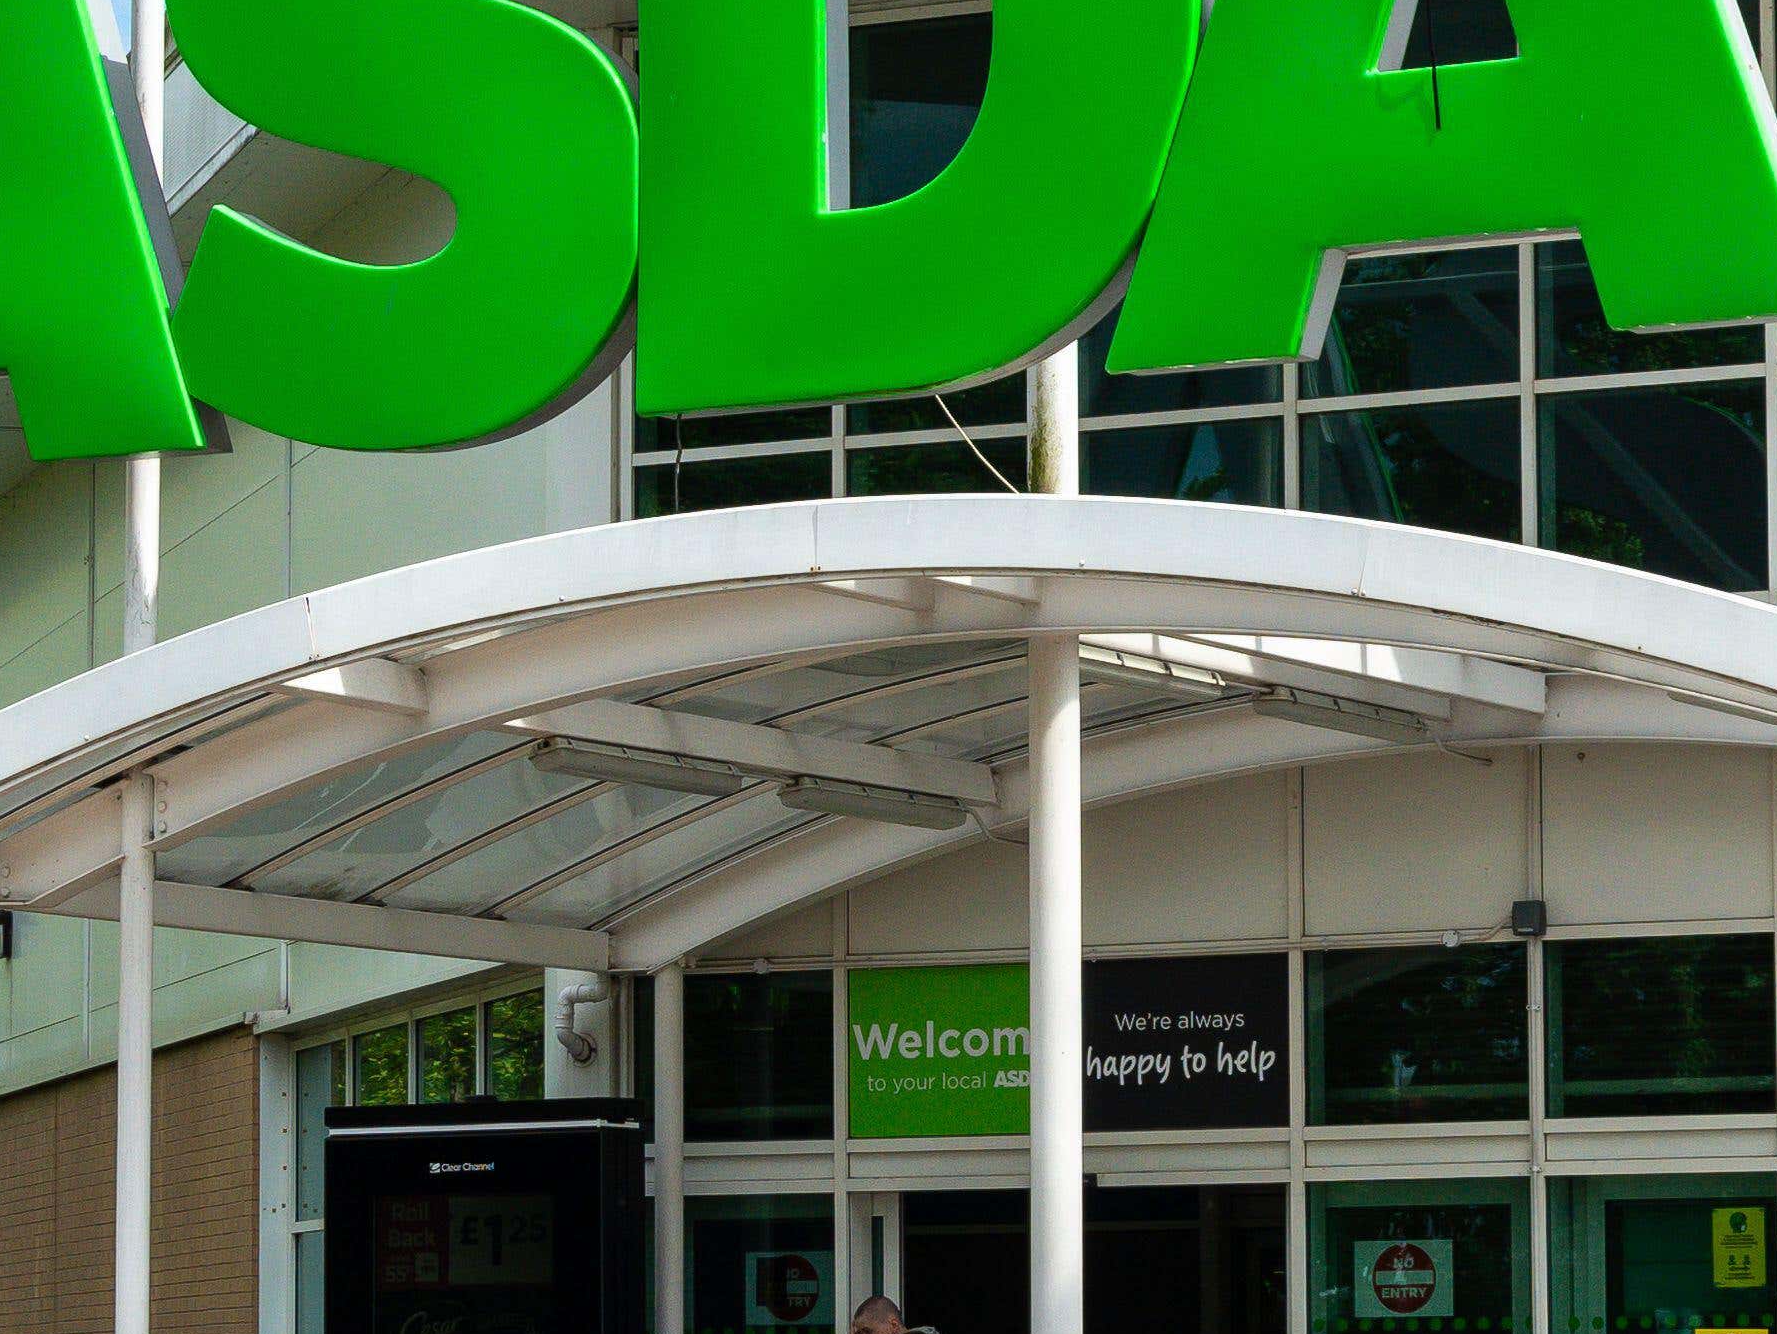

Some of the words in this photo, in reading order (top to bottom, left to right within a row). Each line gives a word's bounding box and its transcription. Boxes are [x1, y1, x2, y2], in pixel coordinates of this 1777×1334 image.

[1115, 1013, 1172, 1031] We're
[1177, 1011, 1245, 1031] always
[852, 1020, 1030, 1061] Welcom
[1086, 1046, 1171, 1086] happy
[1180, 1045, 1207, 1079] to
[1217, 1040, 1276, 1081] help
[867, 1075, 887, 1092] to
[893, 1076, 936, 1095] your
[942, 1071, 987, 1090] local
[993, 1070, 1030, 1088] ASD
[442, 1163, 462, 1172] Clear
[1382, 1287, 1427, 1298] ENTRY
